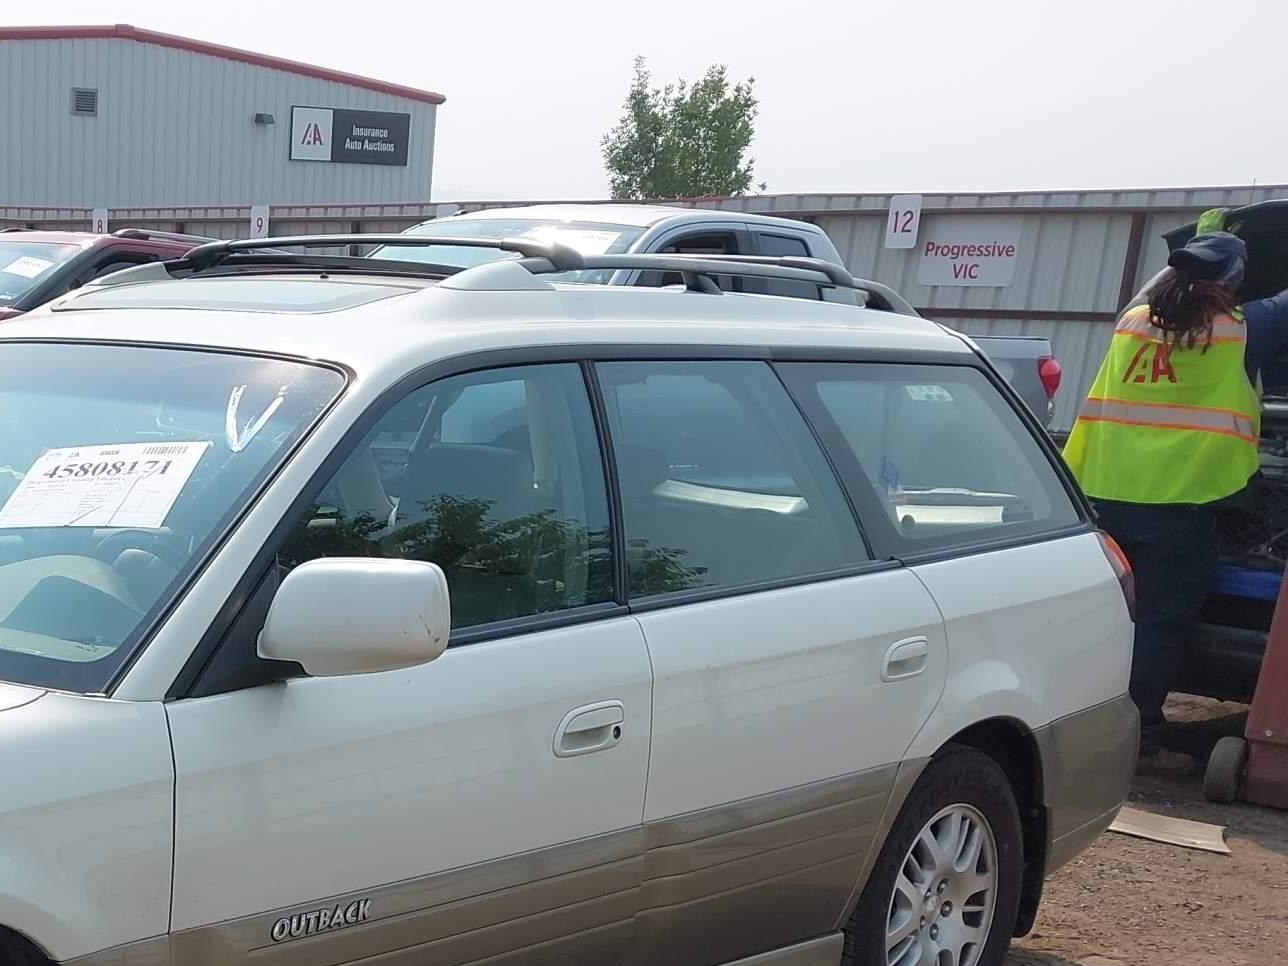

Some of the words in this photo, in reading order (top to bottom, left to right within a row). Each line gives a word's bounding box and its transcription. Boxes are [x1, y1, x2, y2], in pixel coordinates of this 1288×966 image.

[352, 124, 389, 138] Insurance
[344, 138, 362, 151] Auto
[363, 139, 395, 153] Auctions
[893, 210, 914, 234] 12
[925, 241, 1016, 260] Progressive
[953, 263, 980, 280] VIC
[43, 459, 174, 479] 45808171
[271, 899, 372, 942] OUTBACK
